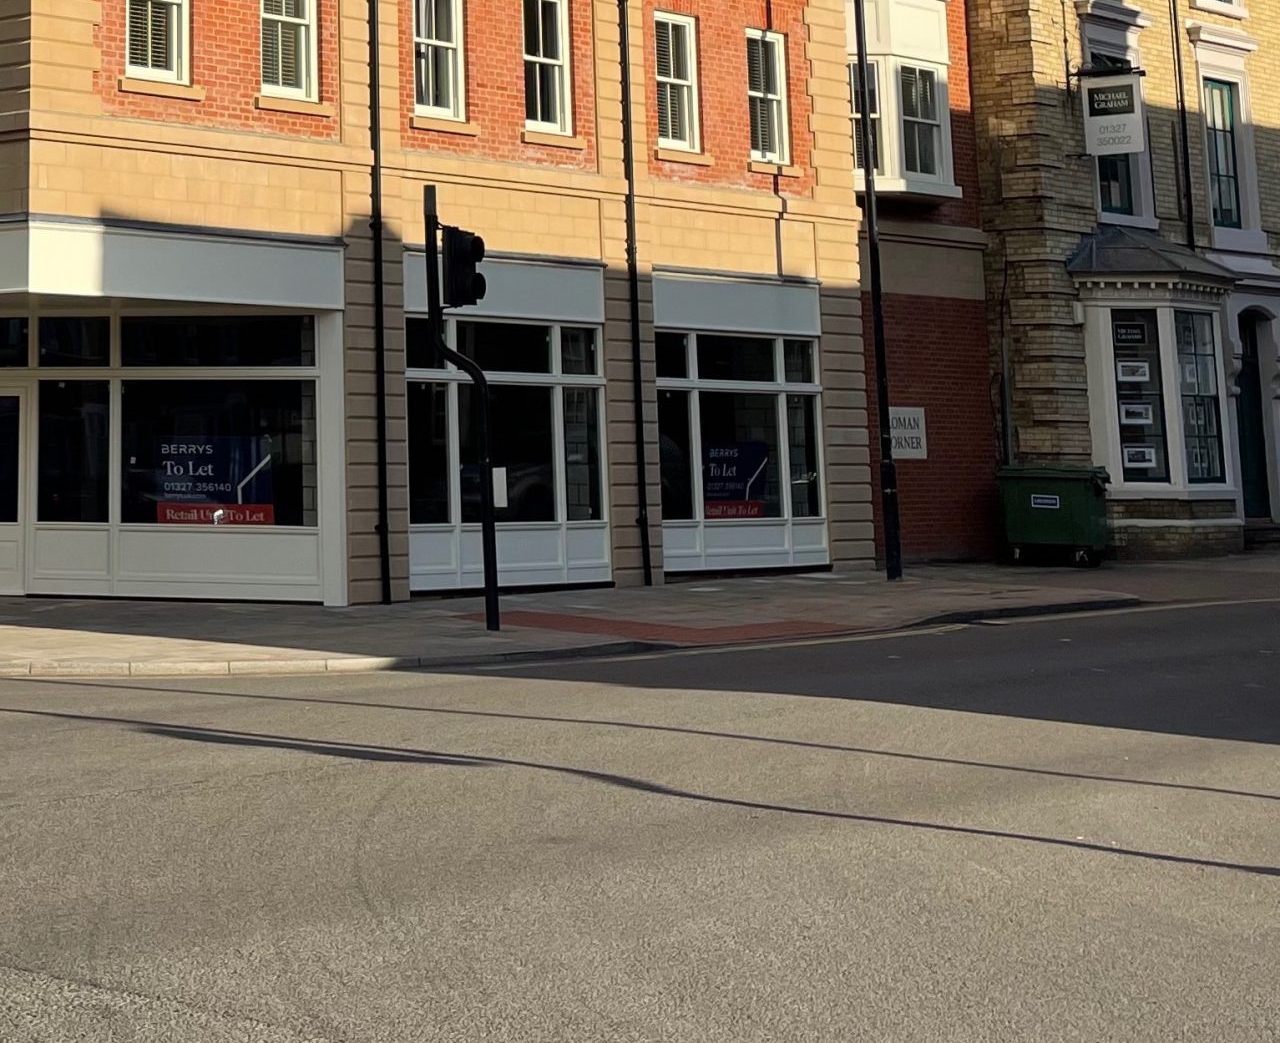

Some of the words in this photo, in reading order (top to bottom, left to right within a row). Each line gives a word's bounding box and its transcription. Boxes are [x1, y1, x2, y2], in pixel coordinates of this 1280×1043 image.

[1094, 92, 1128, 102] MICHAEL
[1094, 100, 1129, 109] GRAHAM
[1099, 123, 1127, 134] 01327
[1096, 135, 1132, 147] 350022
[890, 416, 920, 430] OMAN
[891, 436, 922, 449] ORNER
[161, 444, 213, 454] BERRYS
[162, 460, 184, 476] To
[187, 460, 214, 476] Let
[709, 463, 721, 477] To
[722, 463, 737, 477] Let
[164, 482, 193, 492] 01327
[196, 482, 232, 492] 356140
[166, 509, 197, 520] Retail
[229, 509, 244, 522] To
[246, 510, 264, 522] Let
